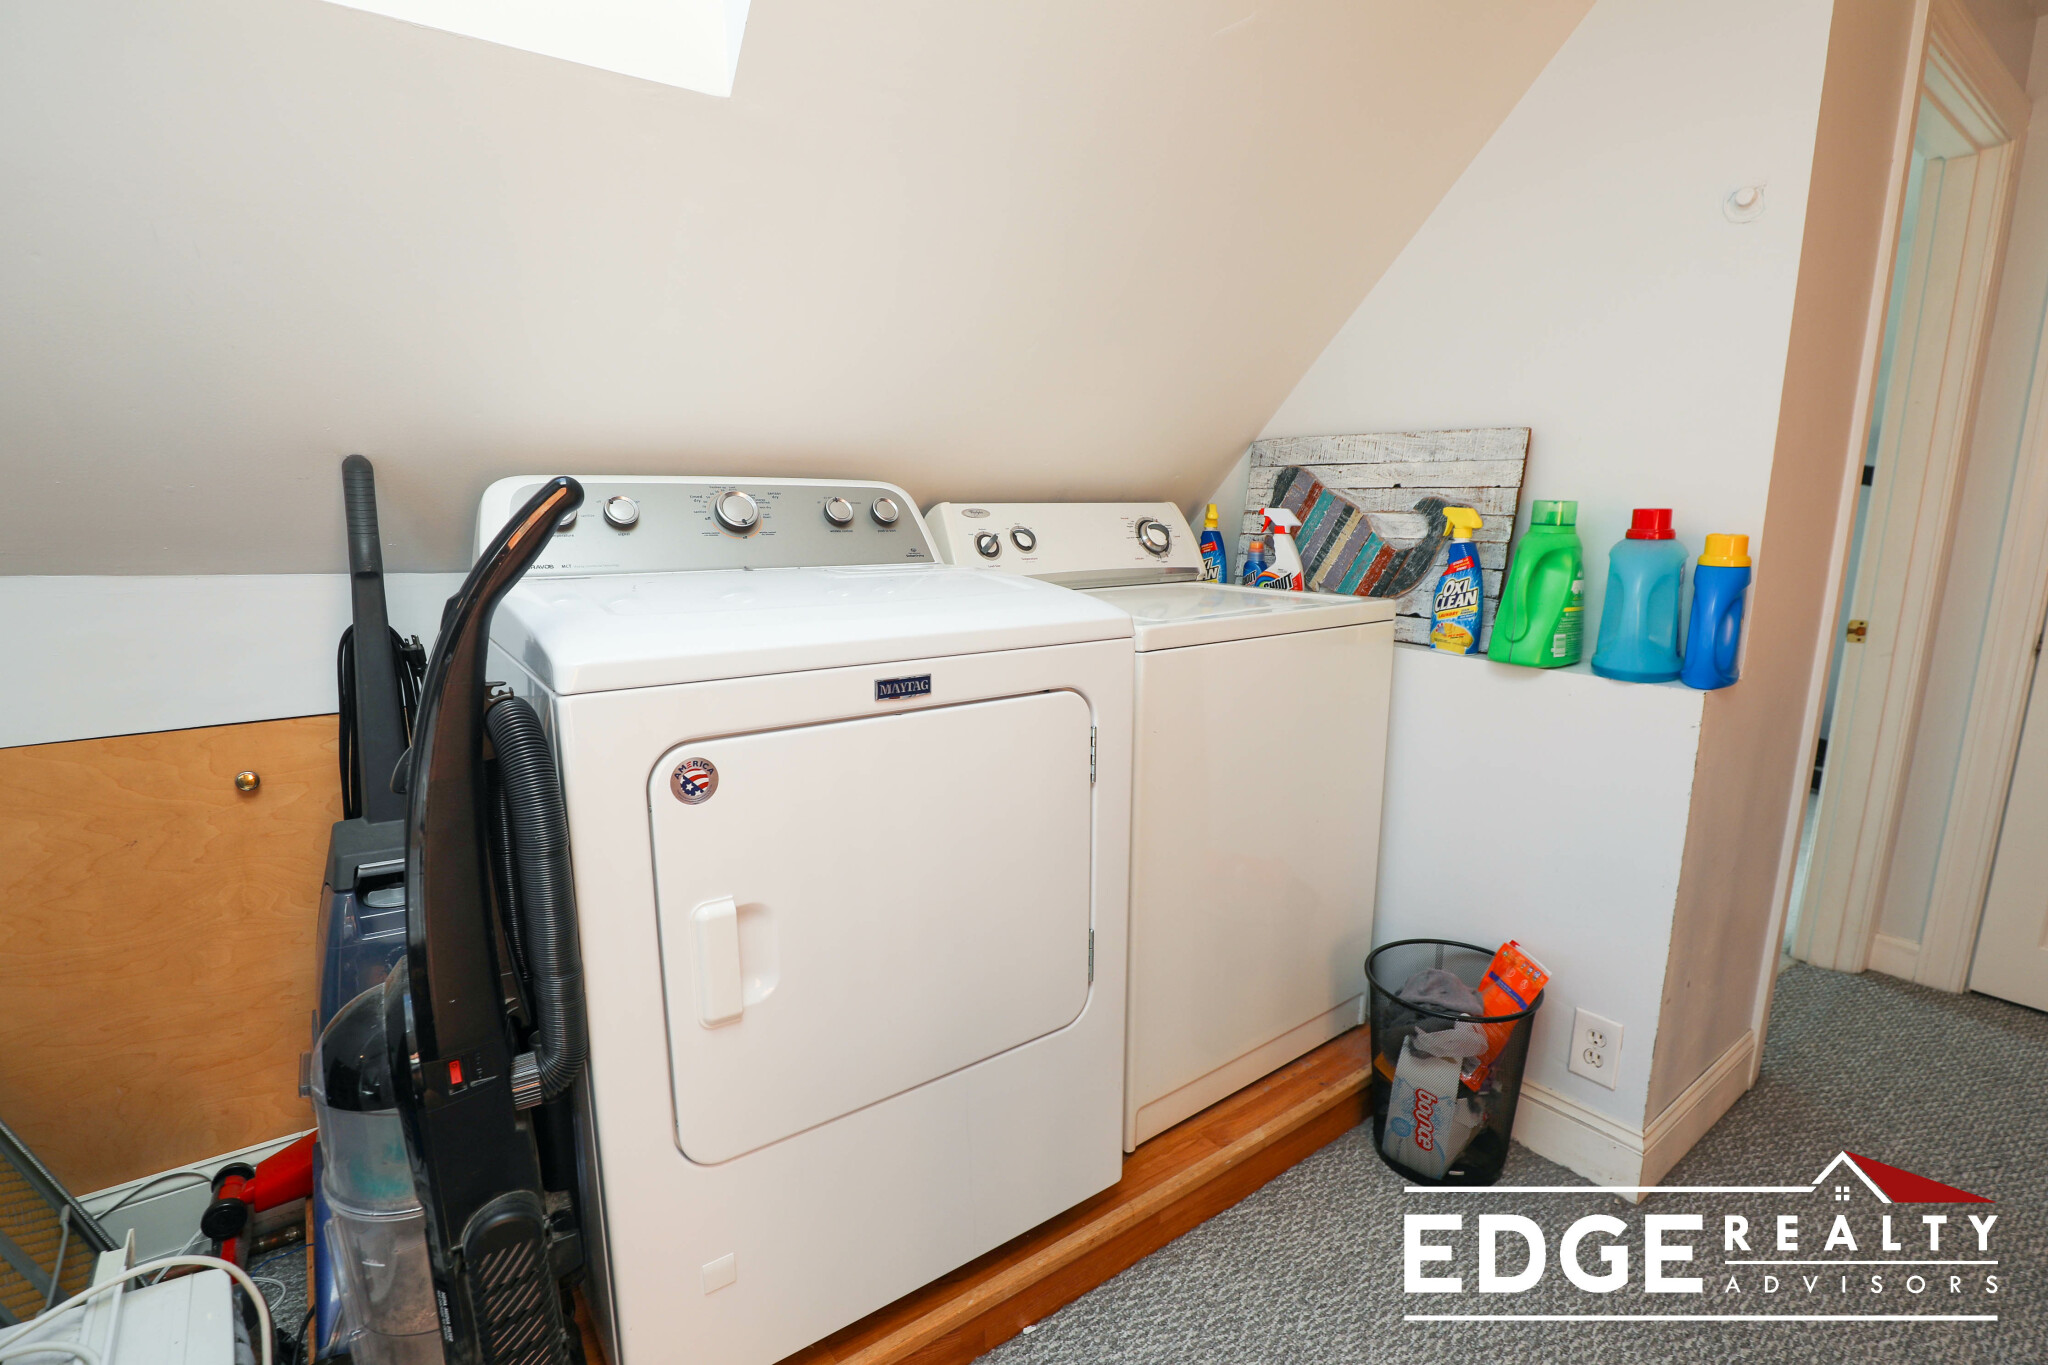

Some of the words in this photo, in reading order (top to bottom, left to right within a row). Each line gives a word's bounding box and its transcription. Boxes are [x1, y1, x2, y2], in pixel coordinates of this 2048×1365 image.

[1443, 578, 1470, 597] OXI
[1434, 590, 1478, 612] CLEAN
[879, 679, 929, 696] MAYTAG
[674, 760, 714, 780] AMERICA
